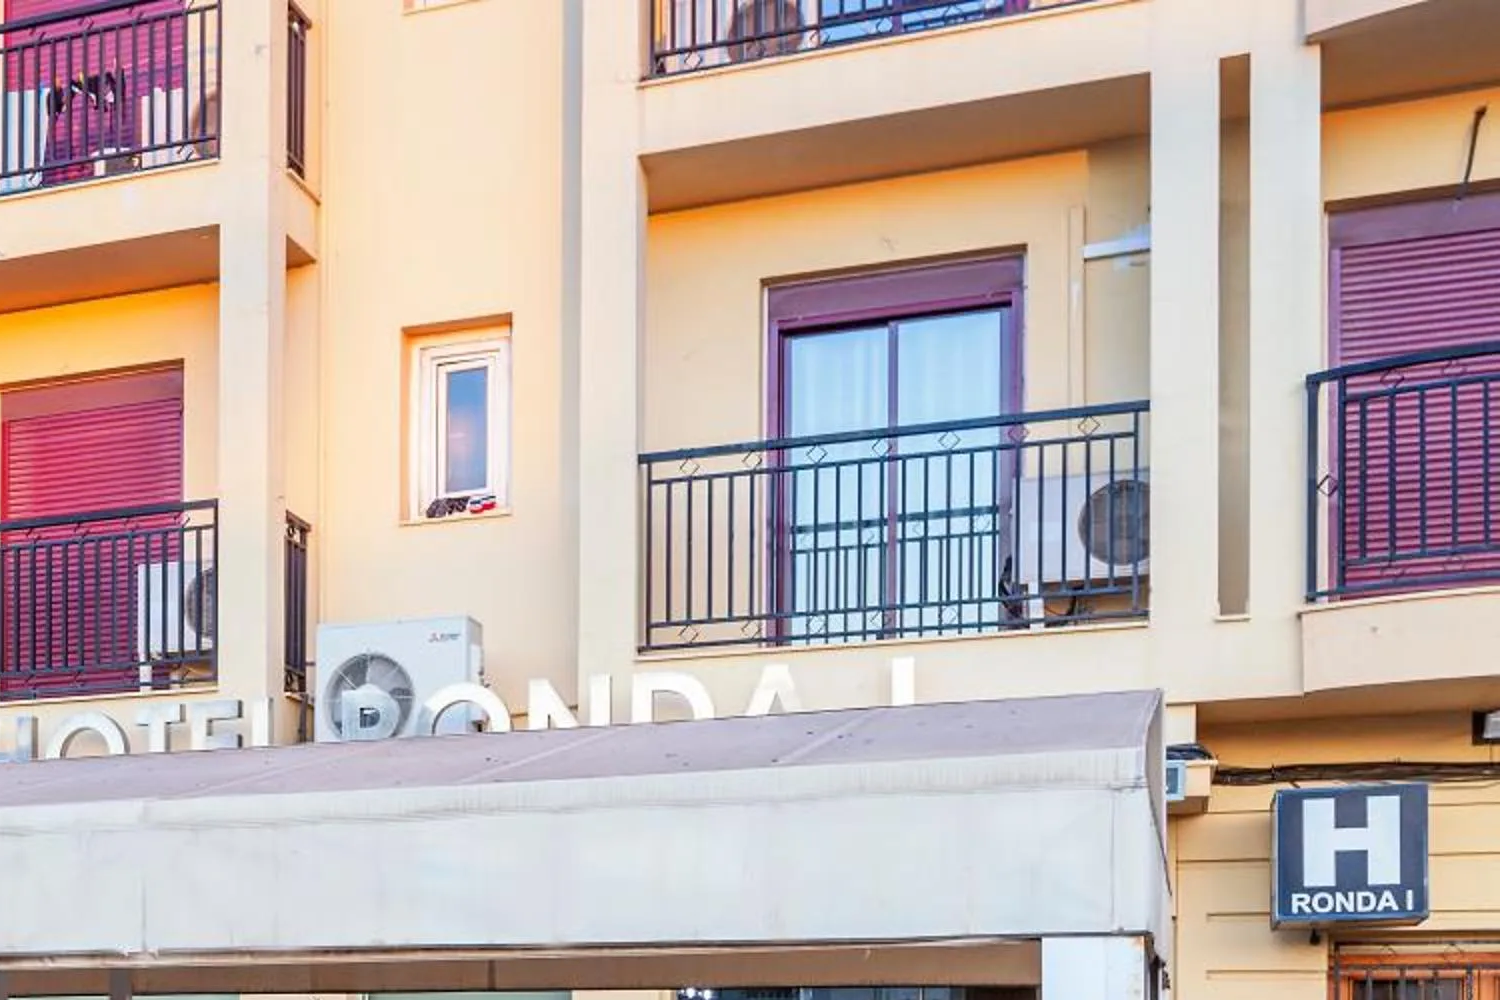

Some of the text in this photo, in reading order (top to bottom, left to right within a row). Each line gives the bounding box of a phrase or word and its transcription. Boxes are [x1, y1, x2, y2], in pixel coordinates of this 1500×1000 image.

[1303, 795, 1401, 887] H
[1291, 890, 1414, 914] RONDA I
